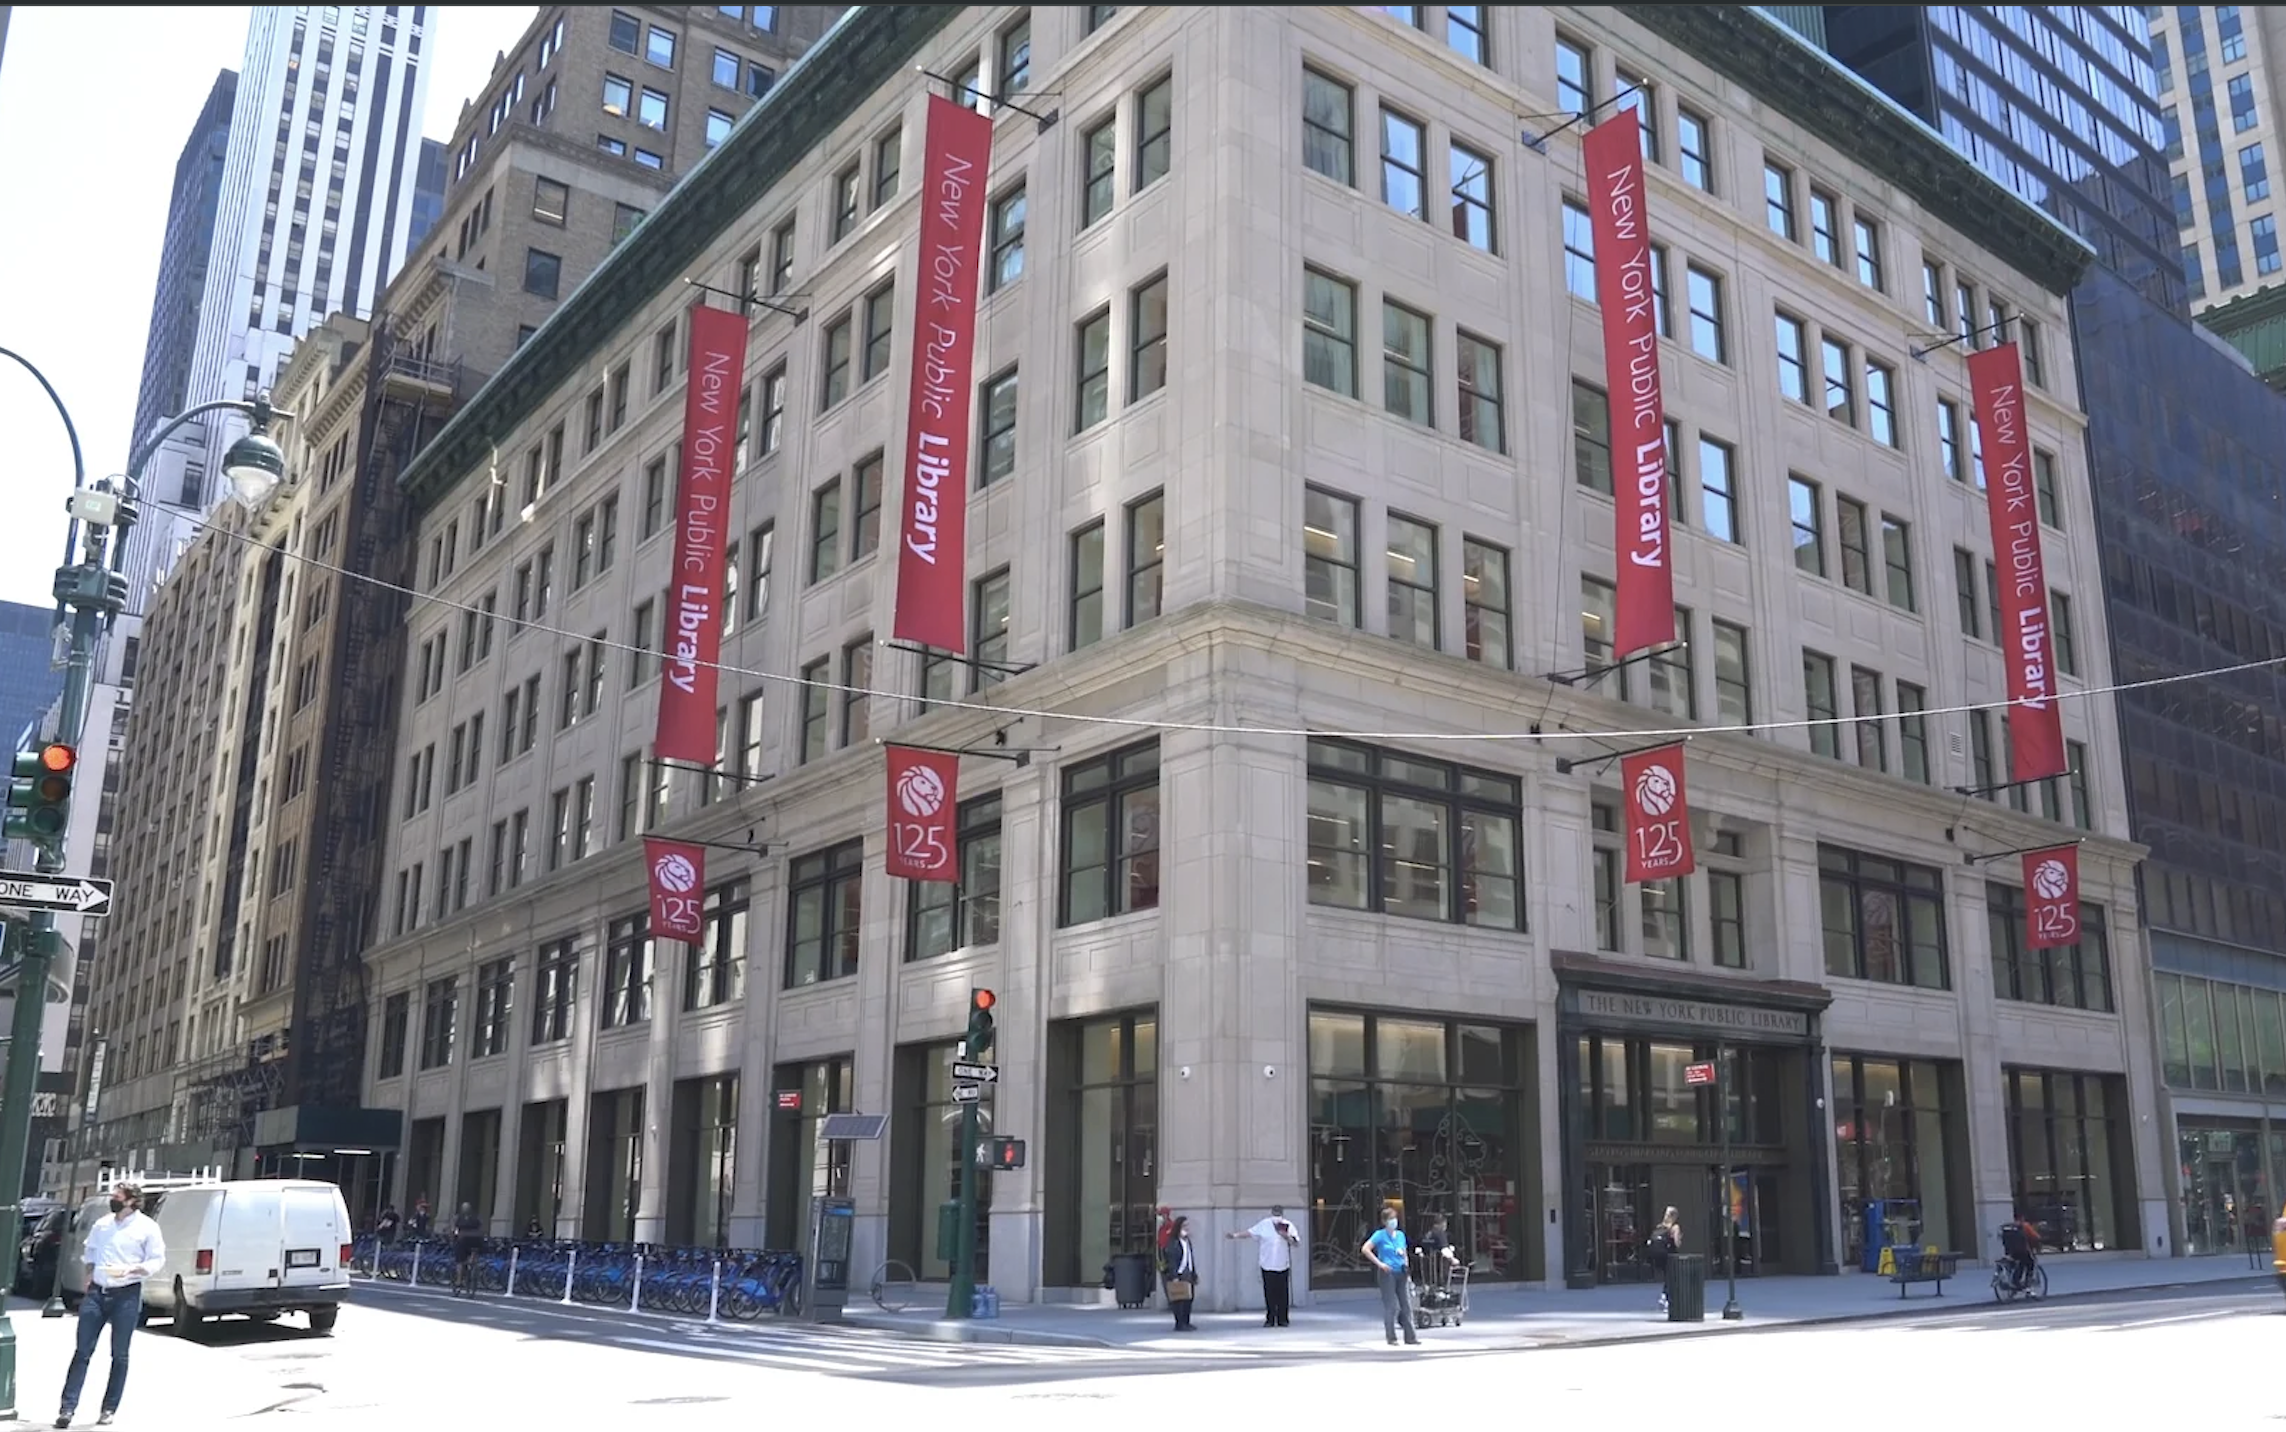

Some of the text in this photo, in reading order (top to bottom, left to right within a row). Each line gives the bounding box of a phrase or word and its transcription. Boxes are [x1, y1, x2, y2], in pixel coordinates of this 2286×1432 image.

[907, 153, 973, 565] New York Public Library
[1607, 164, 1664, 568] New York Public Library
[669, 350, 731, 694] New York Public Library
[1990, 384, 2046, 711] New York Public Library
[894, 822, 947, 869] 125
[899, 855, 926, 869] YEARS
[1635, 820, 1683, 866] 125
[1641, 857, 1669, 869] YEARS
[0, 882, 95, 902] ONE WAY
[656, 894, 701, 934] 125
[2033, 902, 2076, 938] 125
[1587, 995, 1800, 1032] THE NEW YORK PUBLIC LIBRARY
